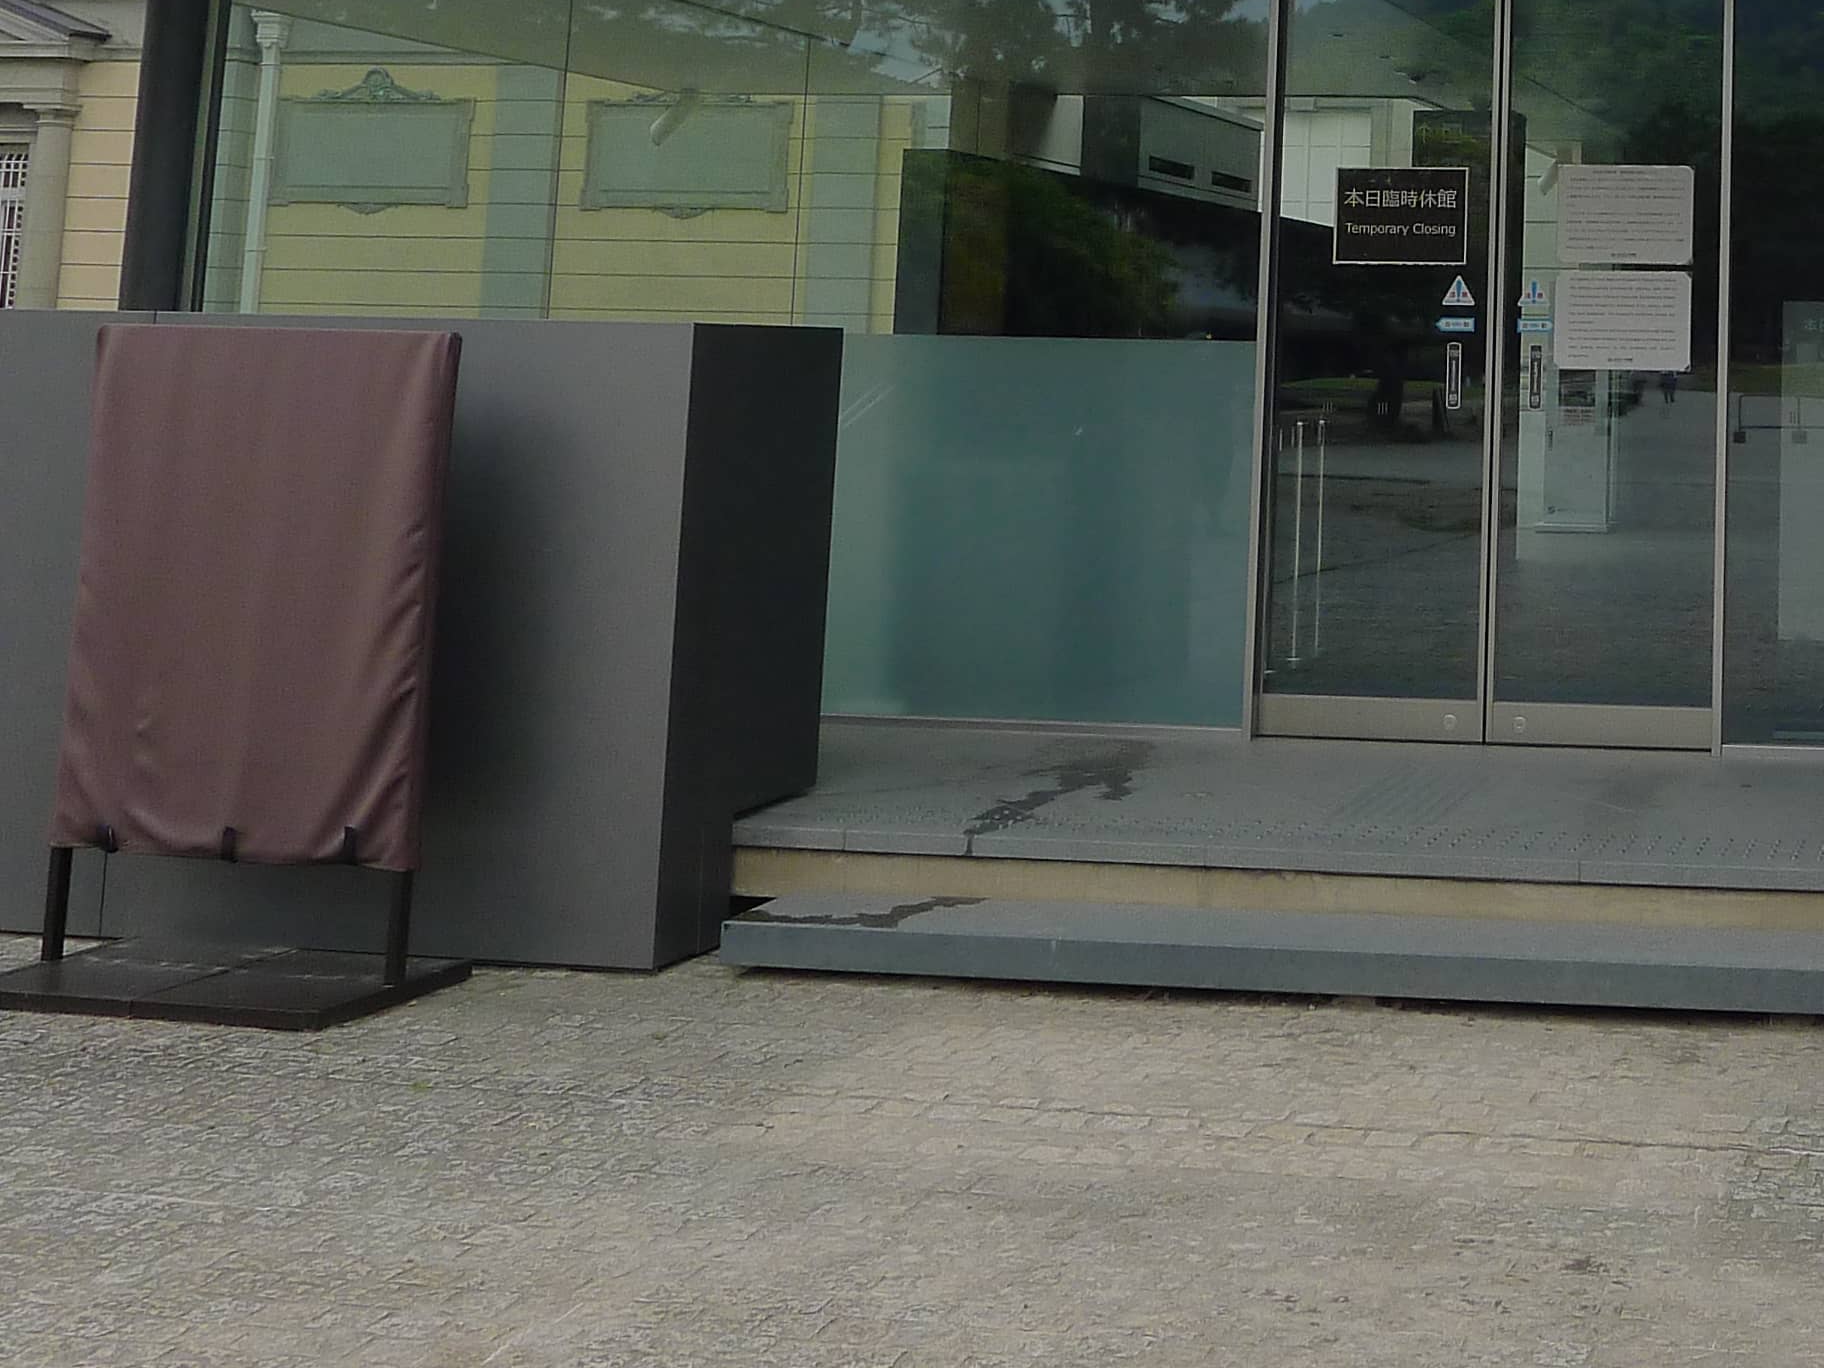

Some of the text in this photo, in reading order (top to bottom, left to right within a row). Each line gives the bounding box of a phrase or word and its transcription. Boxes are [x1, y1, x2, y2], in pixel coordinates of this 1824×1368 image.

[1343, 187, 1457, 209] 本日臨時休館
[1345, 222, 1457, 237] Temporary Closing
